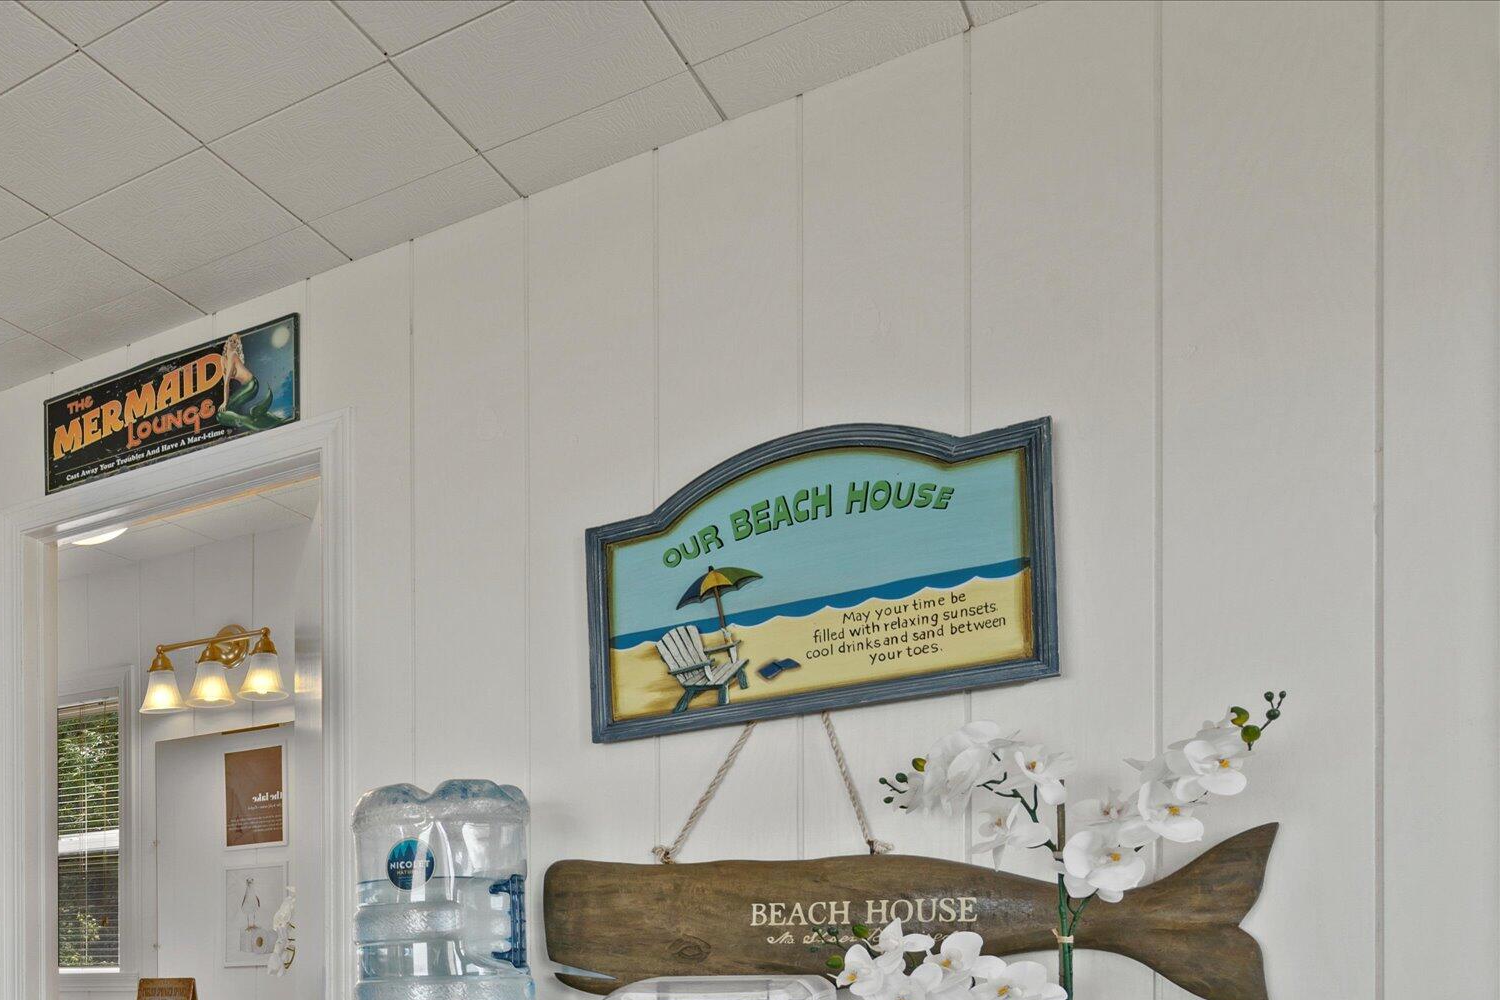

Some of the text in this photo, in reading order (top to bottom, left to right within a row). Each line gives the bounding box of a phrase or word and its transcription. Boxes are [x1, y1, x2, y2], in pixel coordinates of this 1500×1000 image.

[53, 353, 224, 461] MERMAID
[67, 395, 94, 415] THE
[126, 399, 216, 449] LOUNGE
[81, 467, 98, 480] Away
[100, 461, 115, 471] Your
[115, 453, 145, 466] Troubles
[146, 449, 160, 458] And
[161, 442, 179, 451] Have
[662, 480, 955, 568] OUR BEACH HOUSE
[842, 591, 966, 624] May your time be
[806, 616, 1006, 660] cool drinks and sand between
[813, 629, 845, 643] filled
[849, 624, 880, 637] with
[884, 614, 938, 632] relaxing
[869, 642, 943, 665] your toes.
[750, 897, 978, 926] BEACH HOUSE
